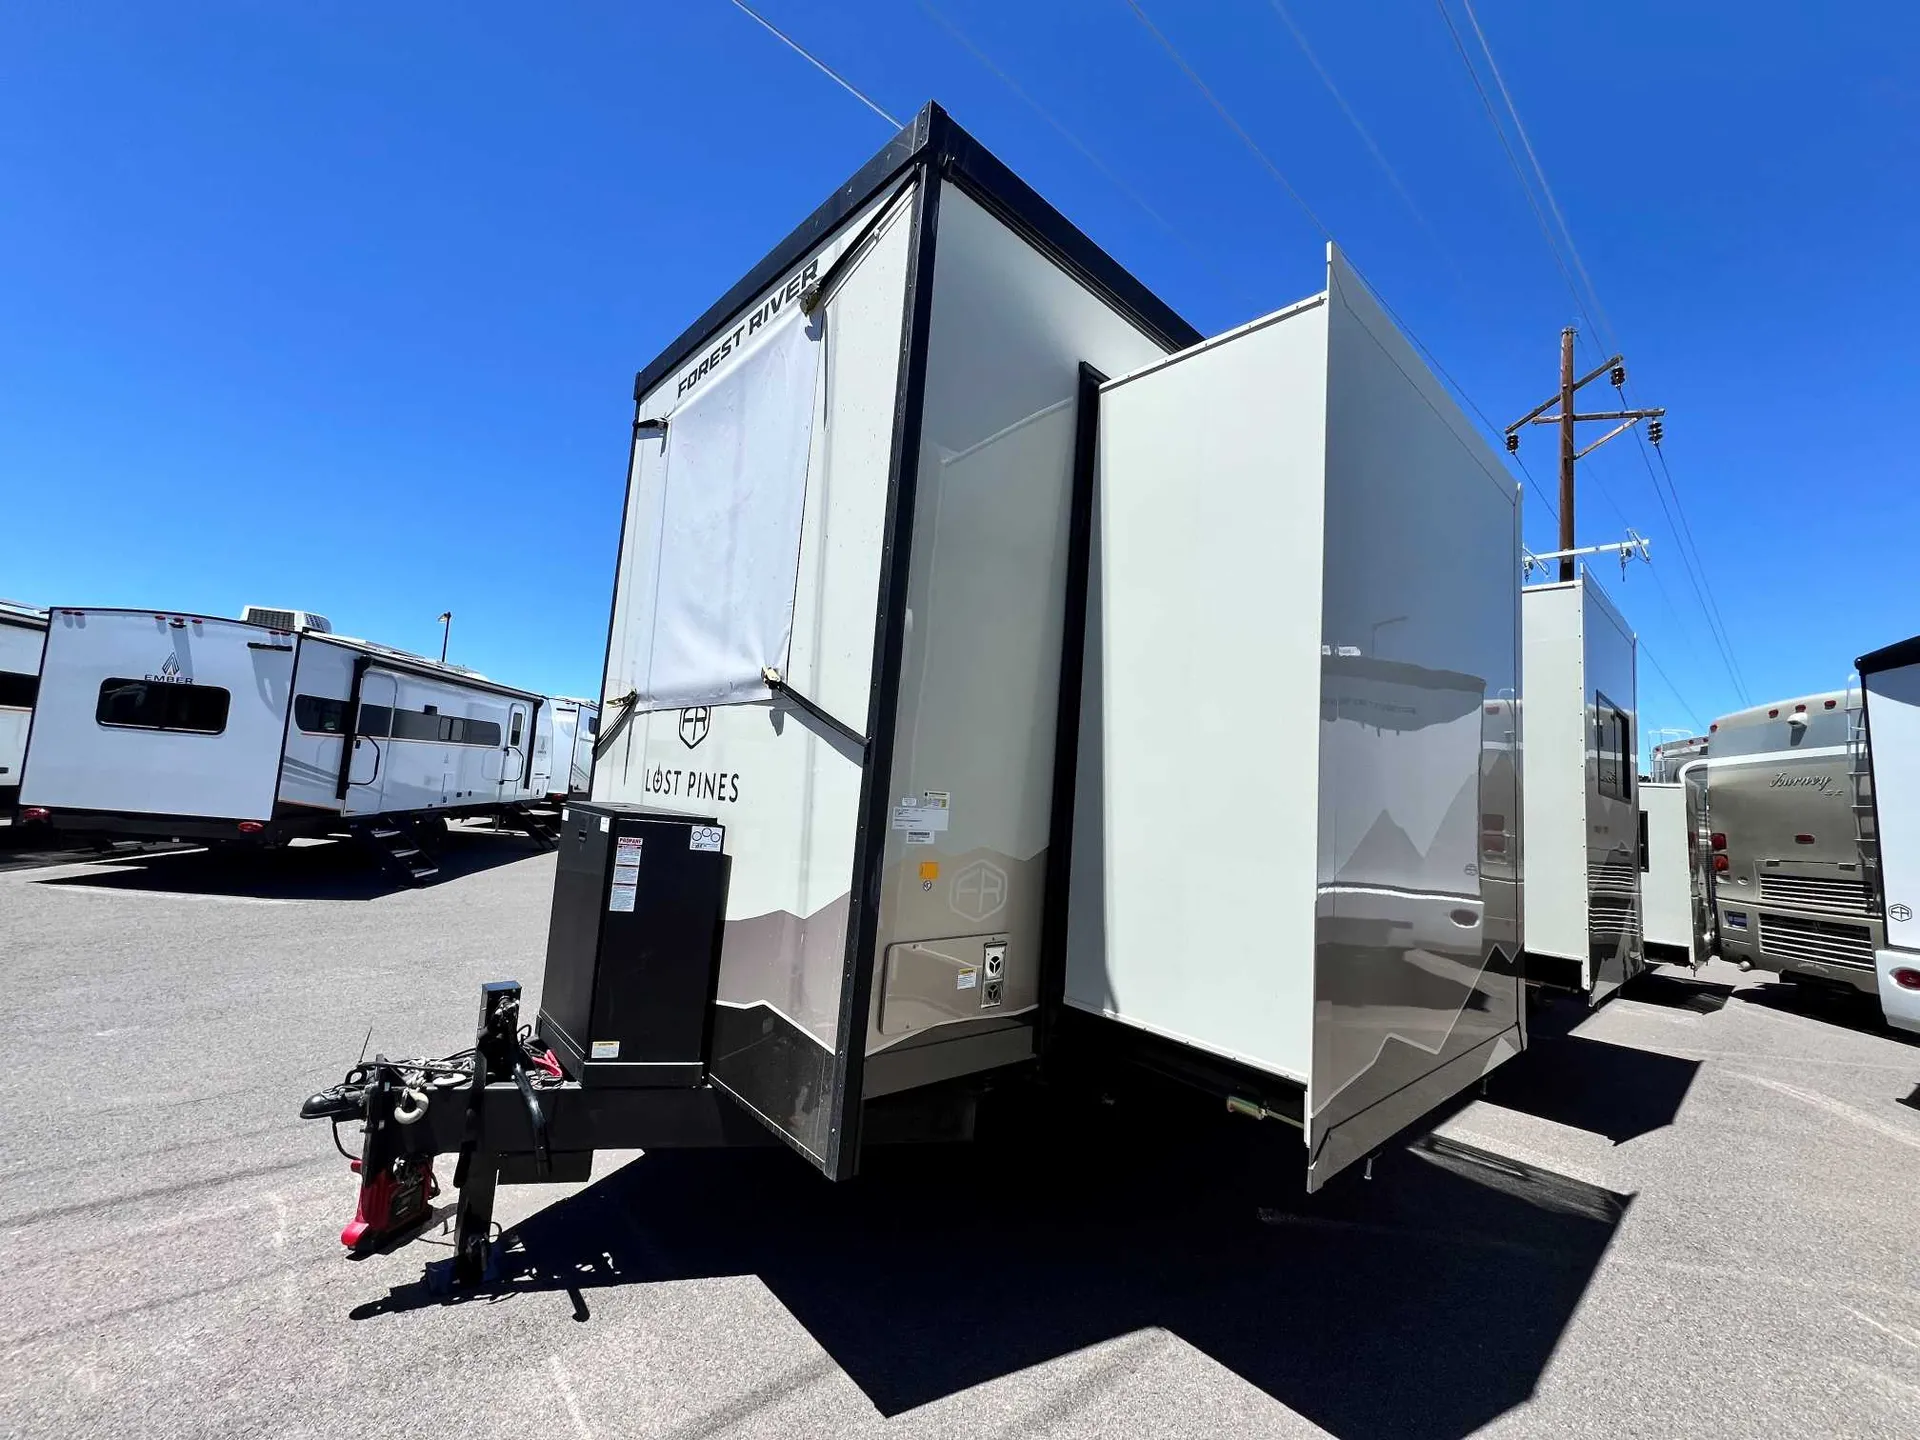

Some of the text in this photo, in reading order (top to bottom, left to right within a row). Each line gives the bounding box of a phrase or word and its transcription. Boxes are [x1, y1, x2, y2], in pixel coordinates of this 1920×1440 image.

[677, 258, 819, 400] FOREST RIVER
[144, 674, 194, 685] EMBER
[645, 763, 740, 803] LOST PINES
[1769, 771, 1832, 792] Journey
